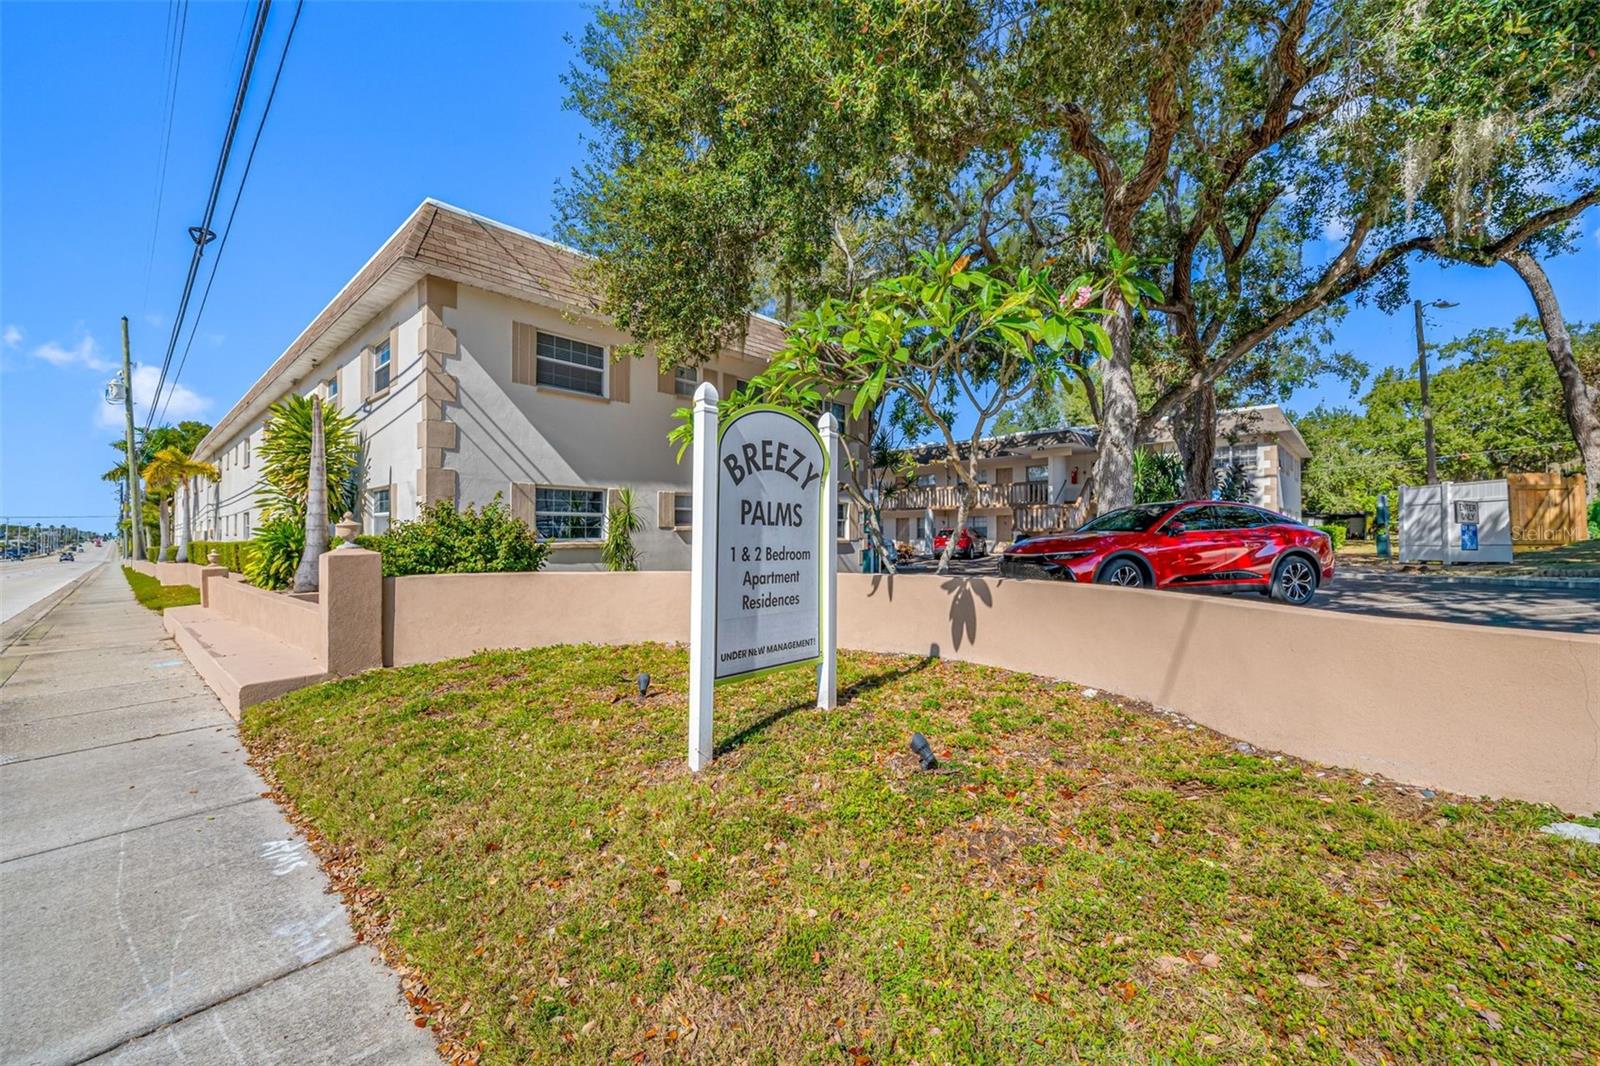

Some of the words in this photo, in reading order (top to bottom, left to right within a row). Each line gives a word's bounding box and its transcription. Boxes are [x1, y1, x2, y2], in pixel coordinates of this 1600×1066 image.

[723, 440, 820, 490] BREEZY
[741, 499, 803, 527] PALMS
[730, 546, 736, 562] 1
[741, 546, 751, 562] &
[754, 546, 762, 561] 2
[765, 545, 811, 561] Bedroom
[742, 570, 800, 590] Apartment
[742, 592, 800, 610] Residences
[720, 649, 747, 662] UNDER
[747, 646, 766, 657] NEW
[766, 637, 817, 654] MANAGEMENT!
